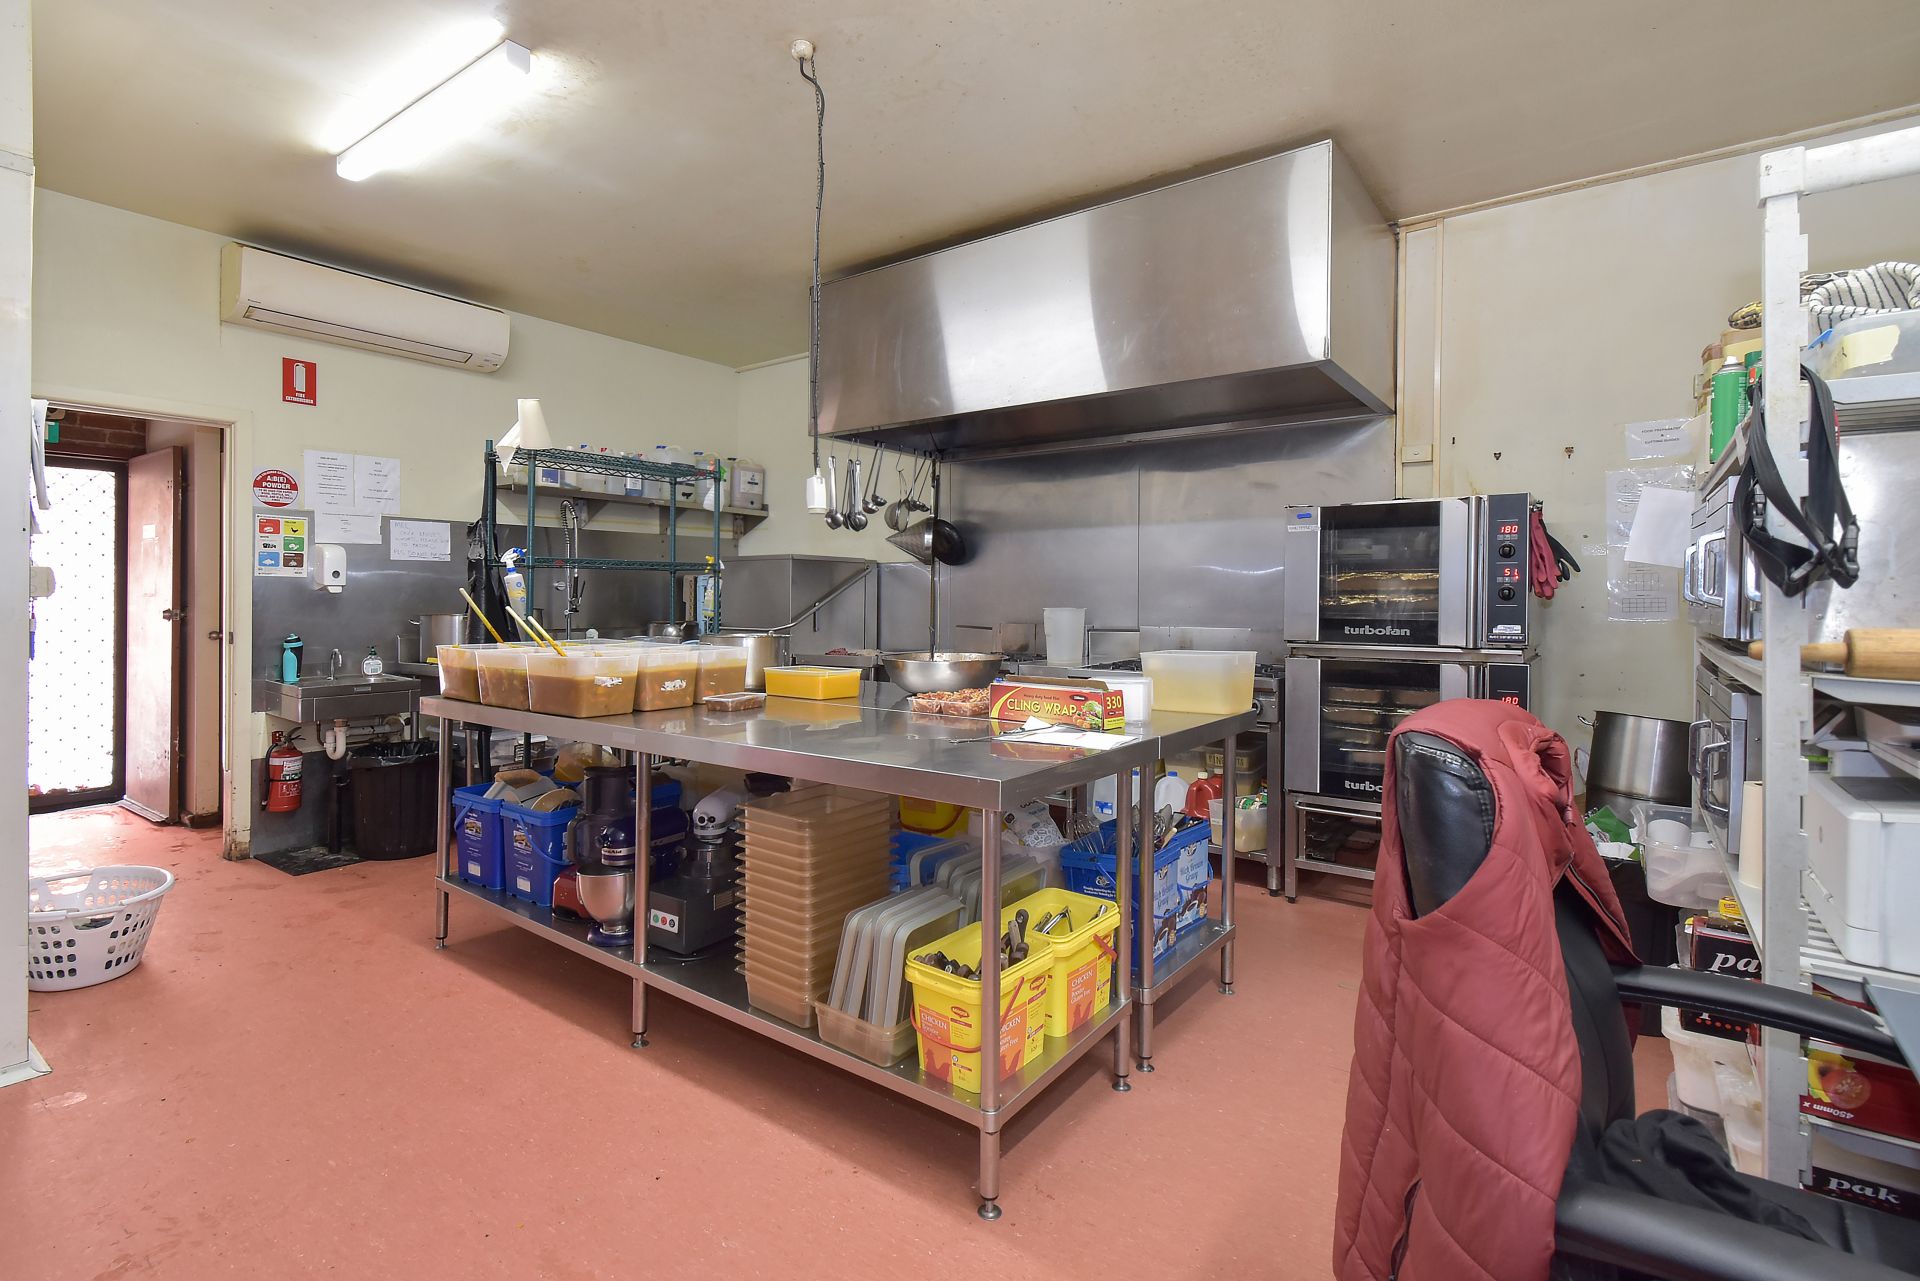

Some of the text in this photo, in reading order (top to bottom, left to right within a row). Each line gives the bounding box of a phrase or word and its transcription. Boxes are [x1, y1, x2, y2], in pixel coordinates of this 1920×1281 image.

[262, 481, 291, 490] POWDER
[1500, 525, 1519, 534] 180
[1344, 624, 1411, 636] turbofan
[1007, 698, 1078, 717] CLING WRAP
[1106, 695, 1122, 710] 330
[1708, 952, 1762, 974] pa
[1071, 970, 1093, 988] CHICKEN
[921, 1010, 948, 1030] CHICKEN
[1000, 1015, 1021, 1035] HICKEN
[1828, 1177, 1901, 1204] pak
